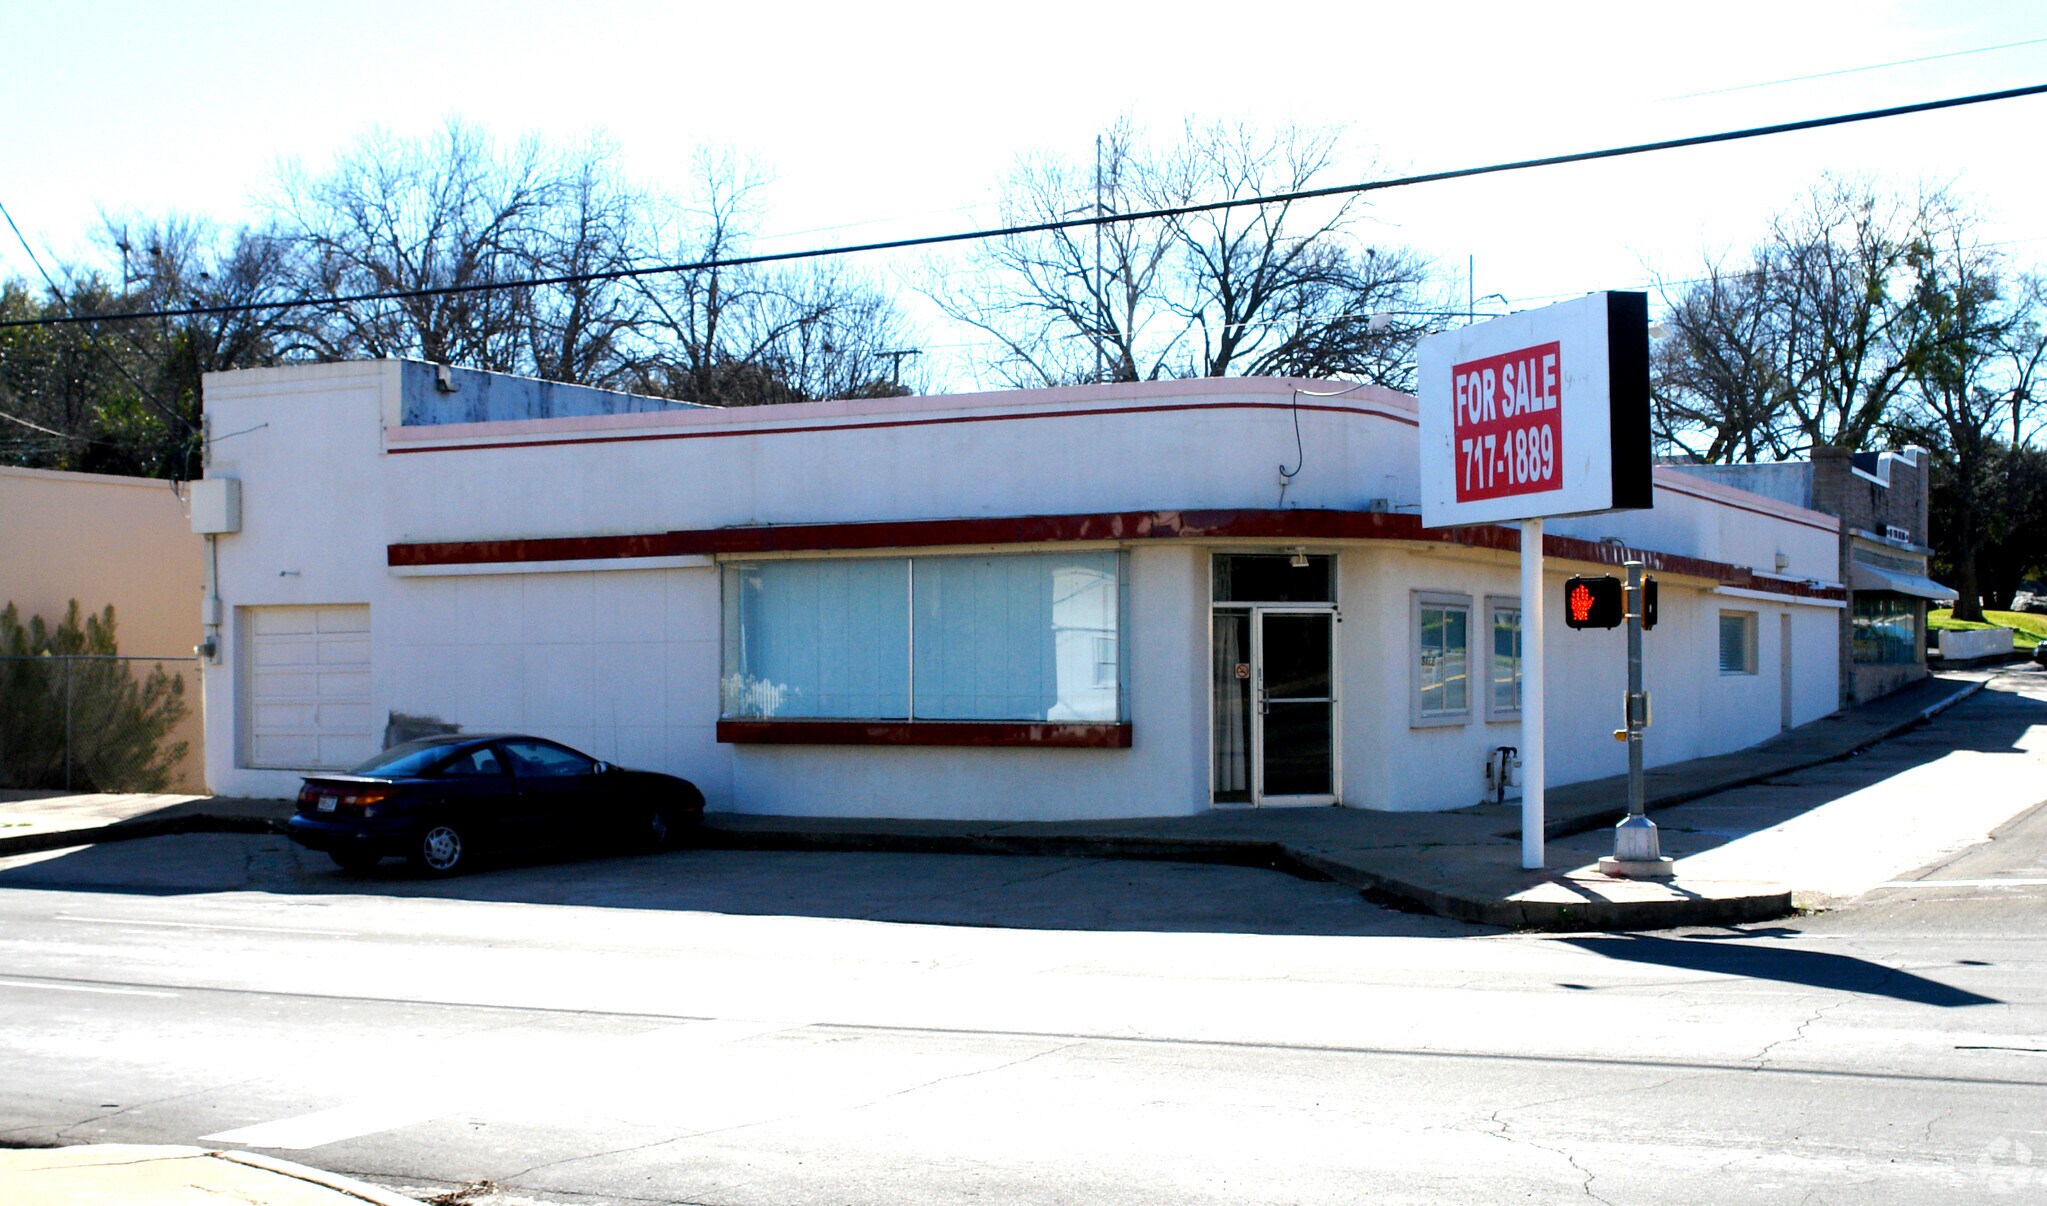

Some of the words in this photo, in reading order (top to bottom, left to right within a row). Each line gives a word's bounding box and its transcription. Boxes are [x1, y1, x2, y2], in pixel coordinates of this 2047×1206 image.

[1456, 369, 1496, 427] FOR
[1502, 354, 1557, 419] SALE
[1462, 424, 1553, 491] 717-1889
